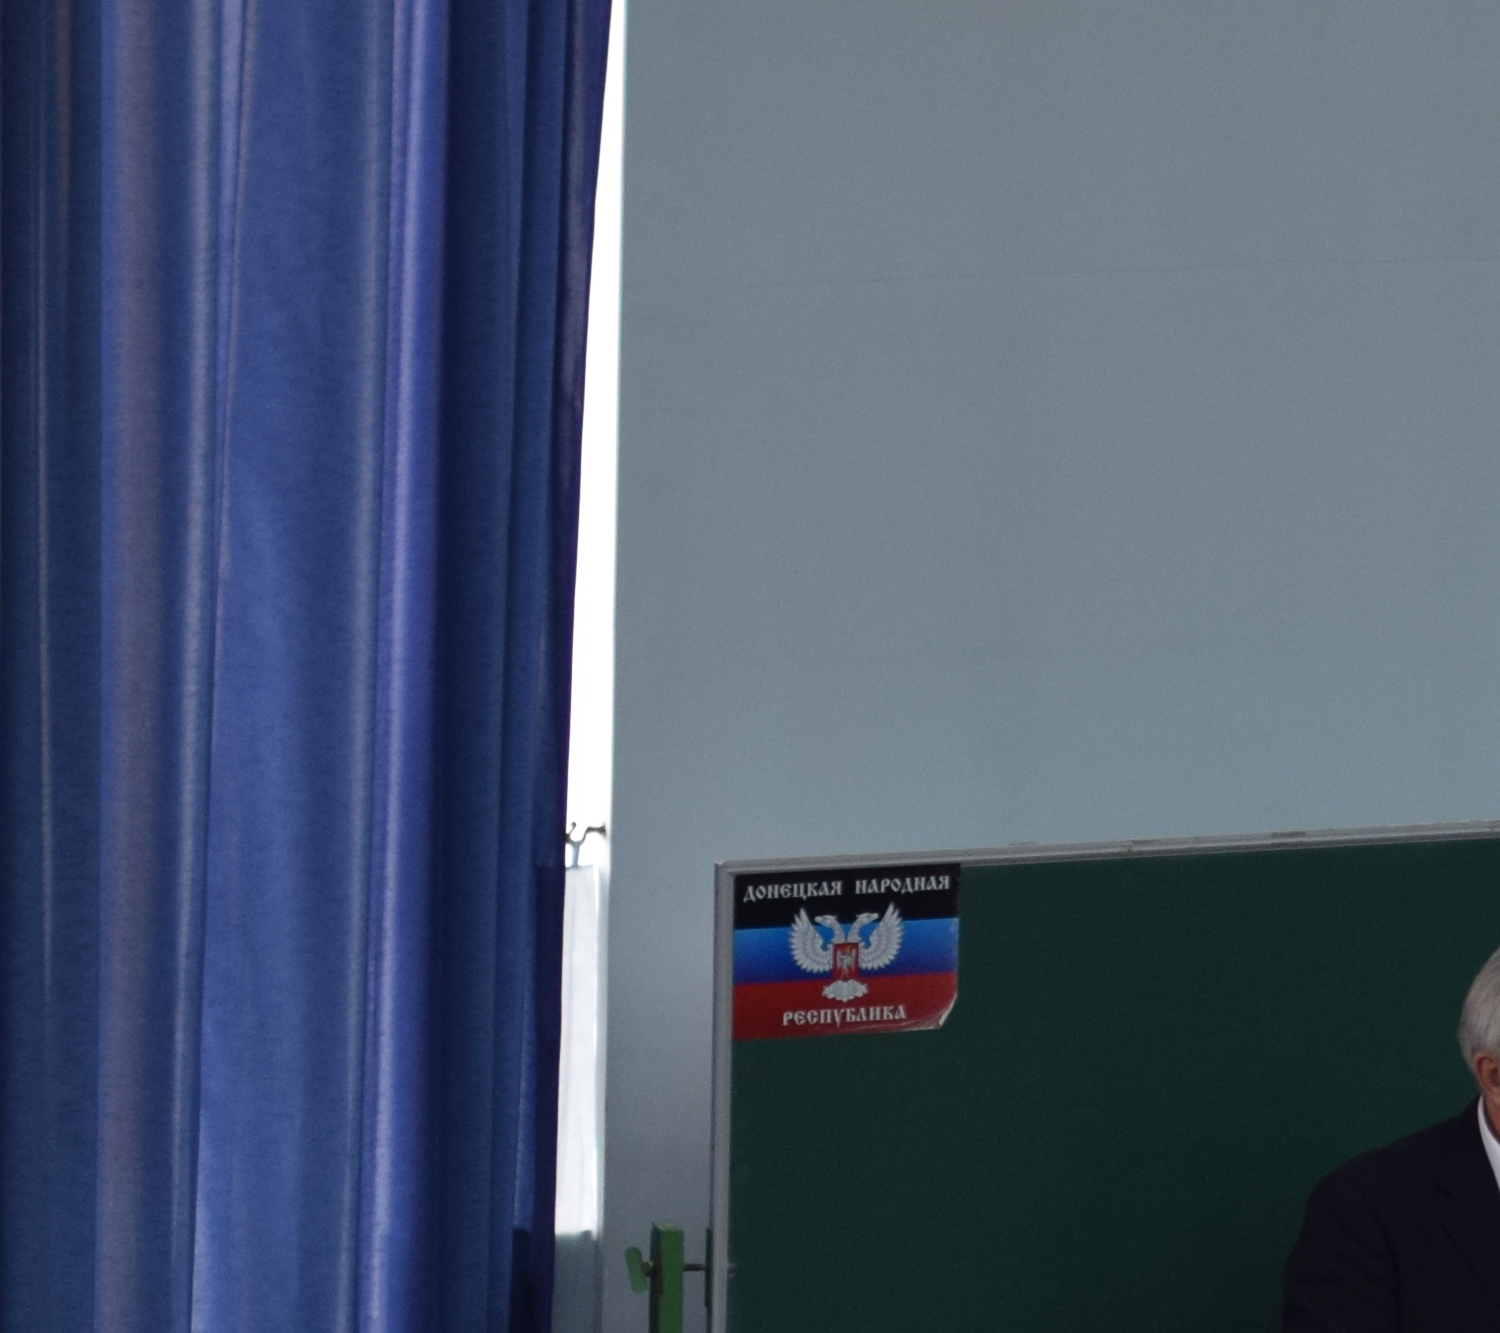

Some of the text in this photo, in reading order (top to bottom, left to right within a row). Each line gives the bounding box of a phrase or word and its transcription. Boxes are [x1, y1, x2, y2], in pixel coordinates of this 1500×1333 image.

[743, 875, 950, 902] ДОНЕЦКАЯ НАРОДНАЯ
[782, 1005, 906, 1027] РЕСПУБЛИКА
